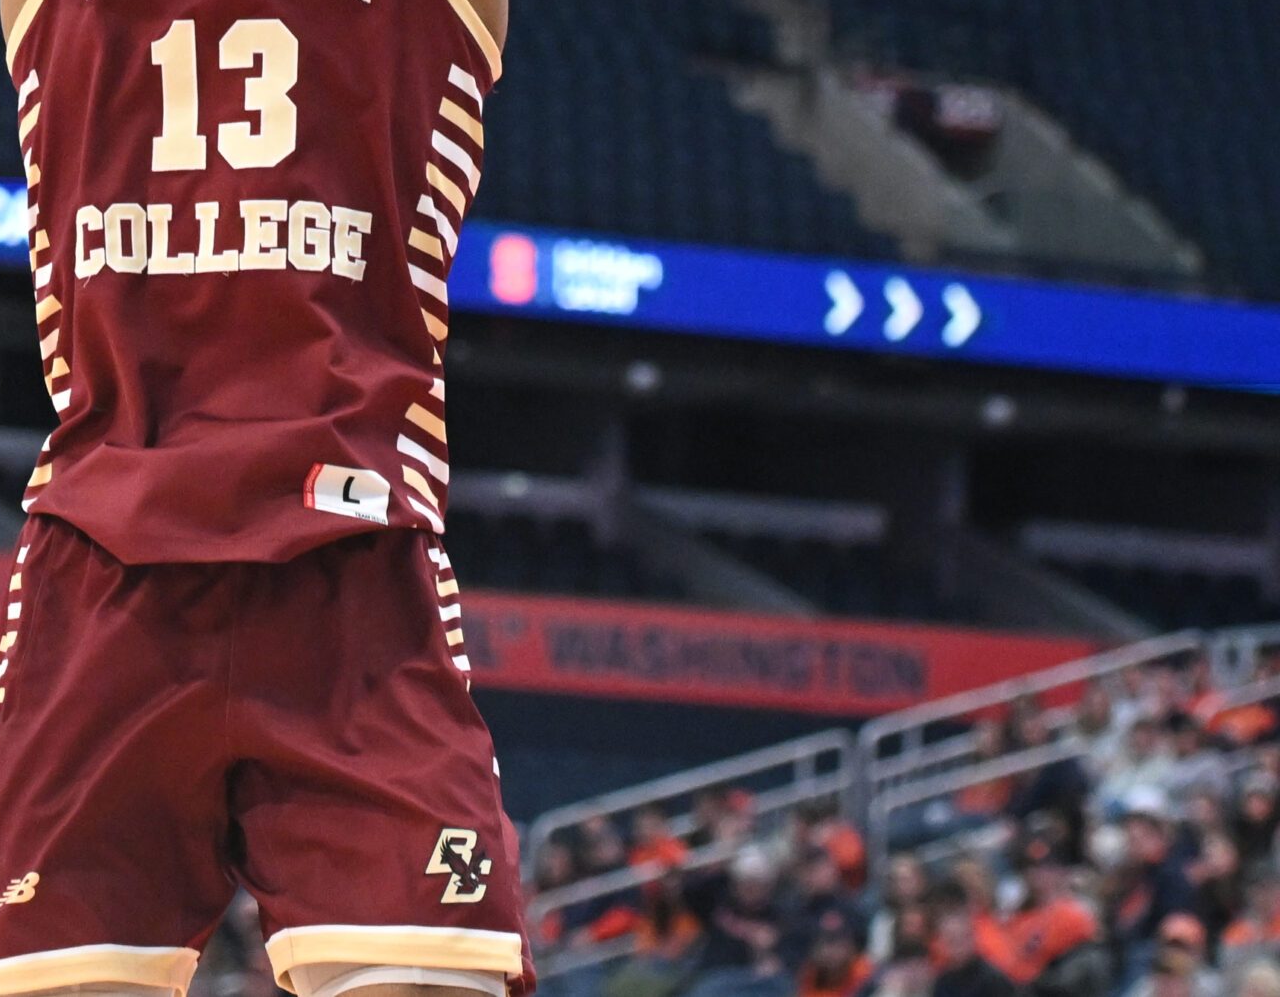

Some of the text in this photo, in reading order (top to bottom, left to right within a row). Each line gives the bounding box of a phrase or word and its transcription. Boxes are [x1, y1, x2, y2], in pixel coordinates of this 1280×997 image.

[151, 19, 298, 172] 13
[75, 200, 372, 283] COLLEGE
[343, 477, 360, 504] L
